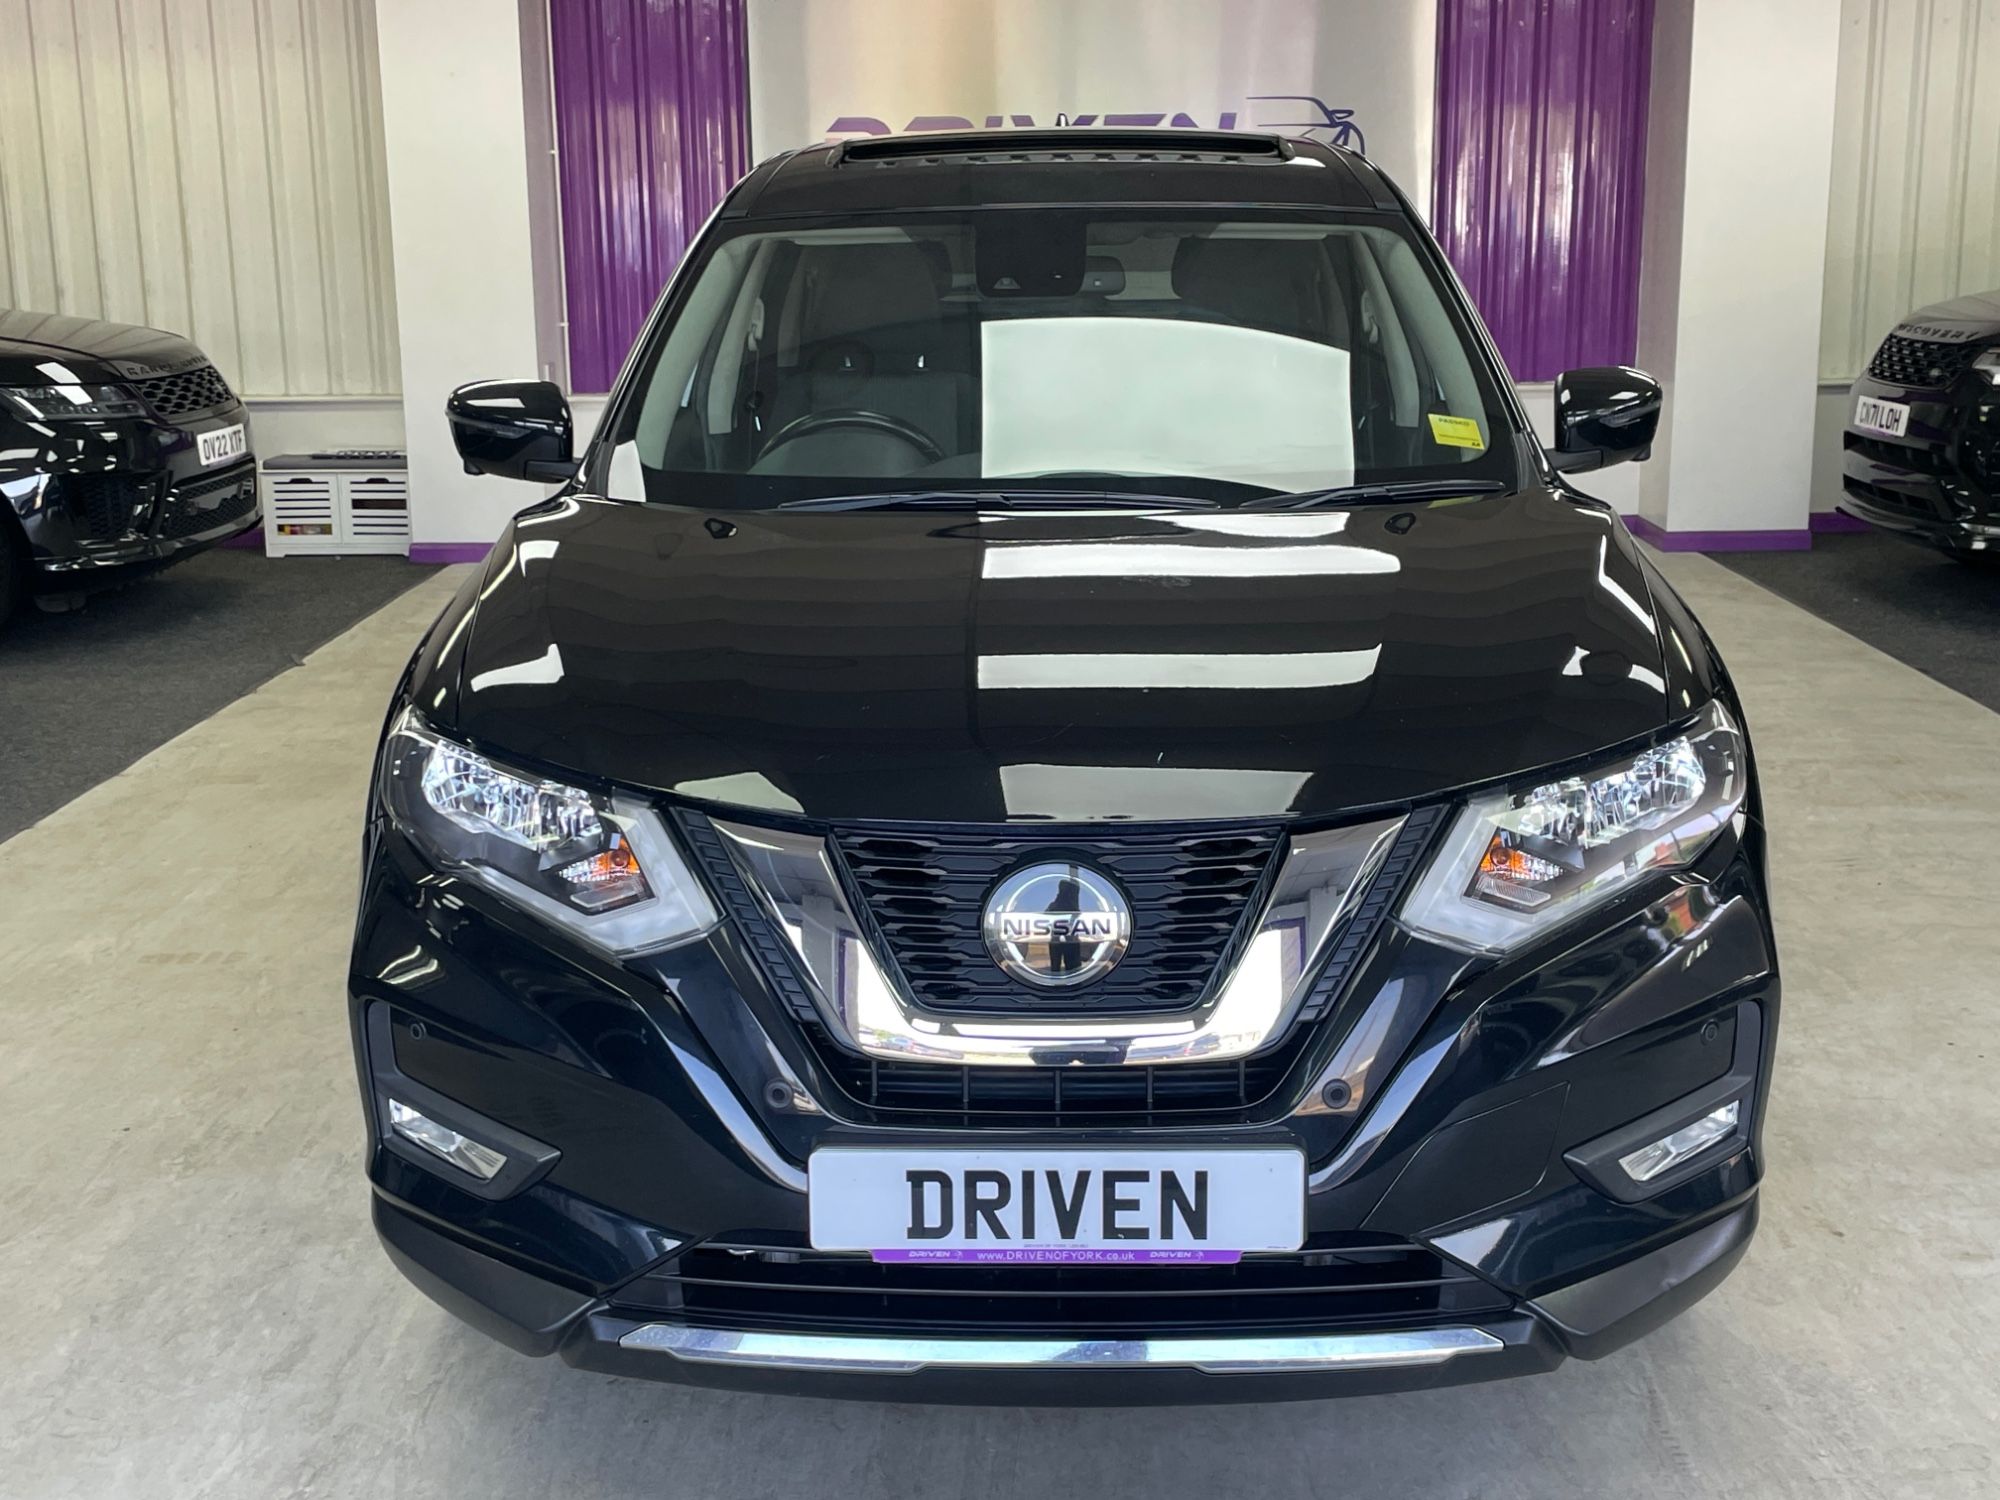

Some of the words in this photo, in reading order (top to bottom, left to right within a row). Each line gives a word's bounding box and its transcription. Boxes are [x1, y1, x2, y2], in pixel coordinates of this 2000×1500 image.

[1879, 406, 1903, 433] LOH
[202, 433, 229, 460] OV22
[1003, 918, 1111, 936] NISSAN
[905, 1170, 1209, 1240] DRIVEN
[976, 1250, 1136, 1261] www.DRIVENOFYORK.co.uk
